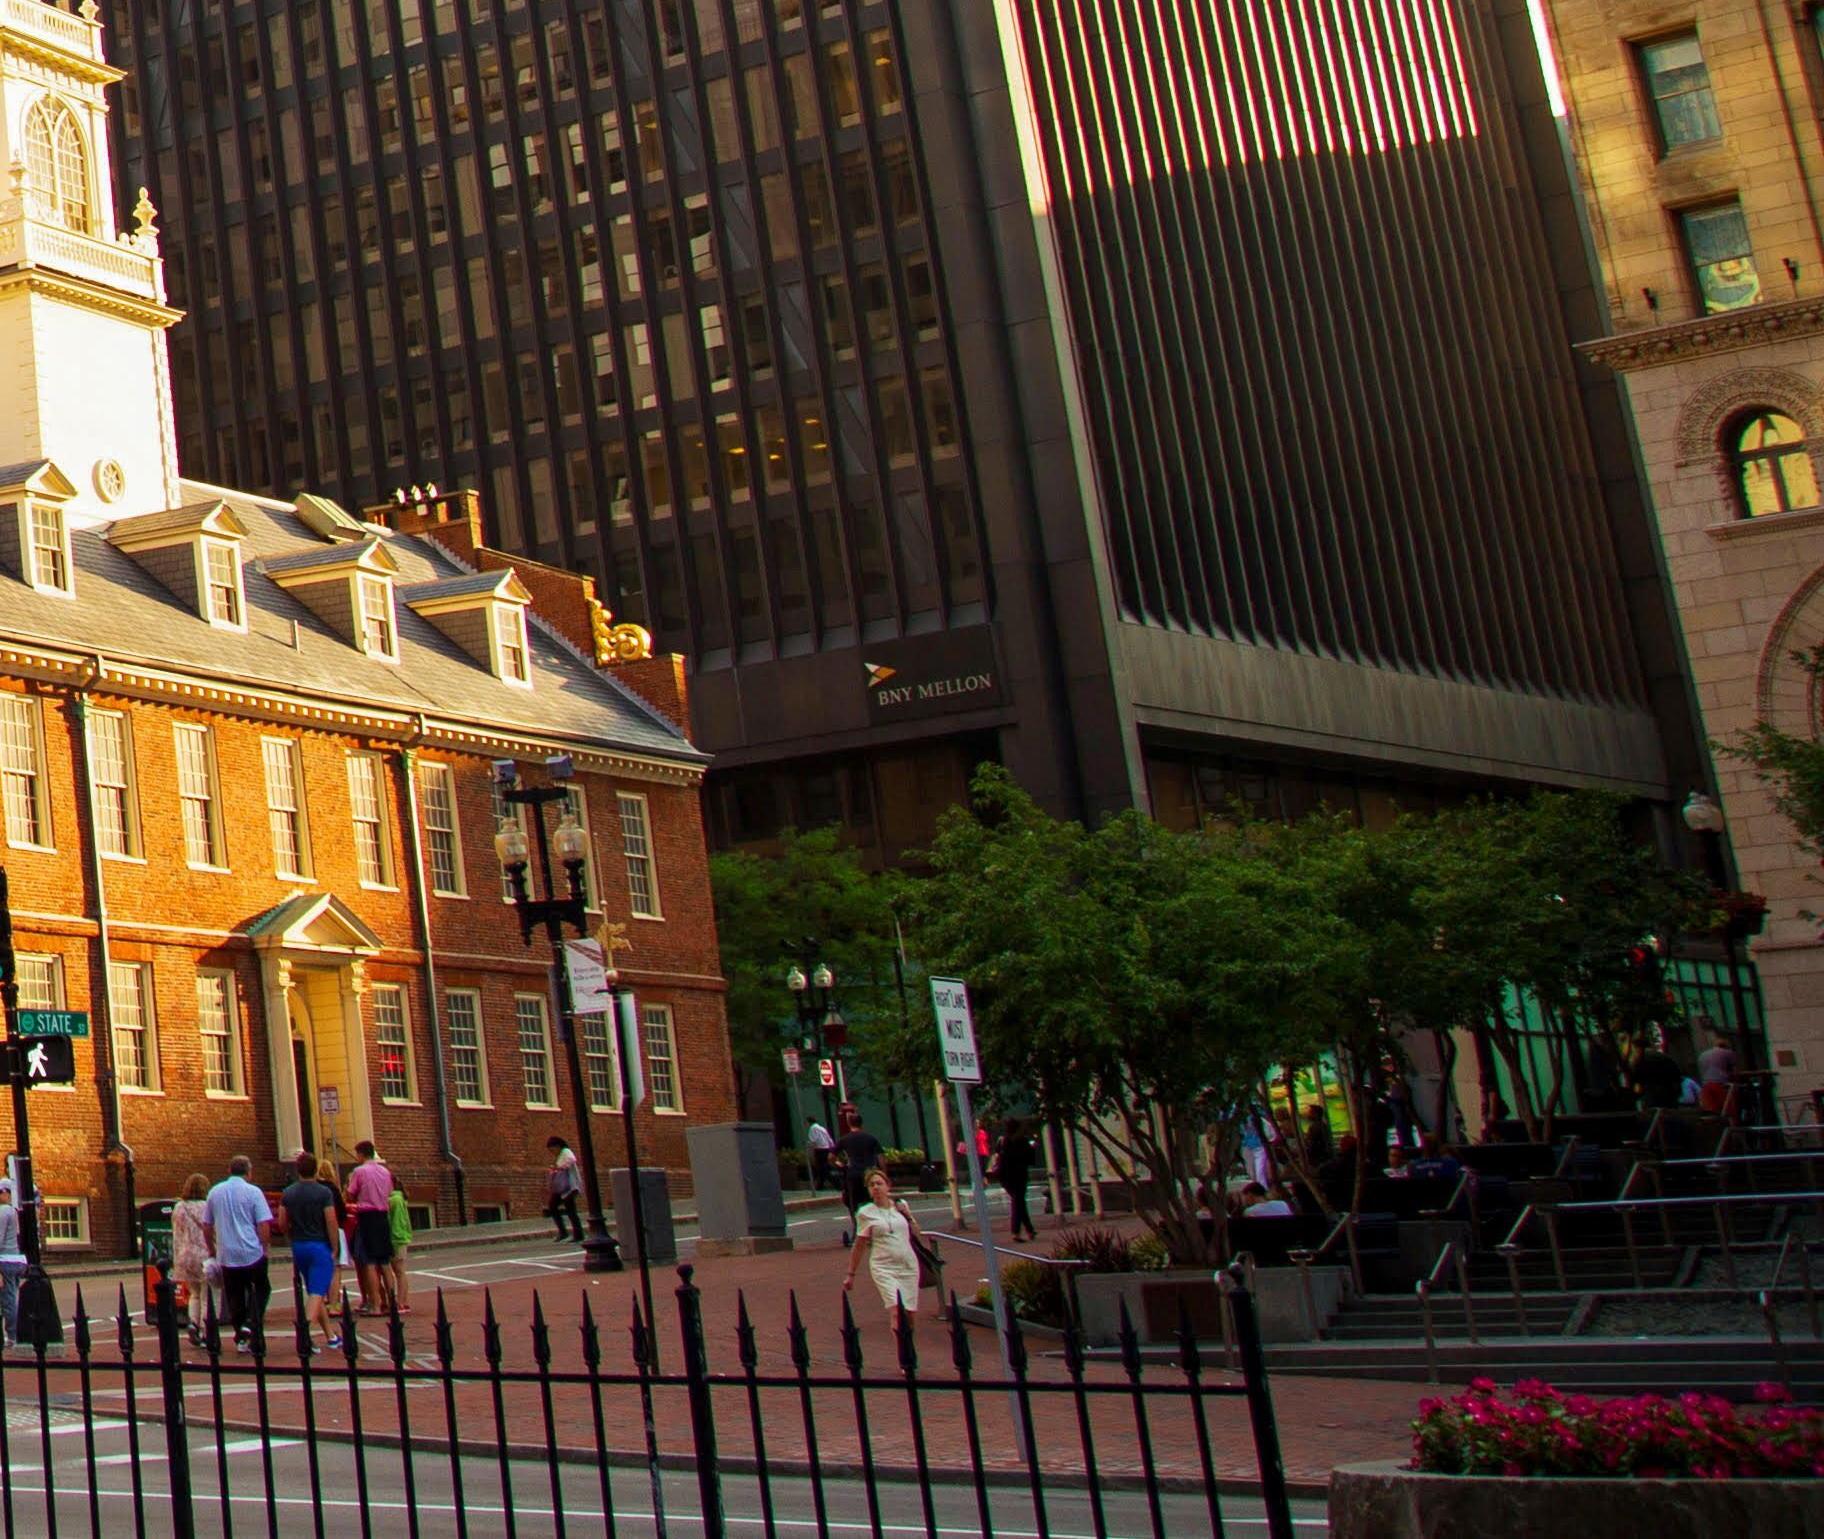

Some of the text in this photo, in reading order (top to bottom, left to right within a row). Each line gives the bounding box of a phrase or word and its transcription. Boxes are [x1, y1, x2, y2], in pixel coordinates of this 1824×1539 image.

[878, 674, 992, 706] BNY MELLON
[935, 990, 966, 1009] RIGHT LANE
[37, 1013, 72, 1033] STATE
[945, 1020, 964, 1039] MUST
[945, 1050, 976, 1068] TURN RIGHT
